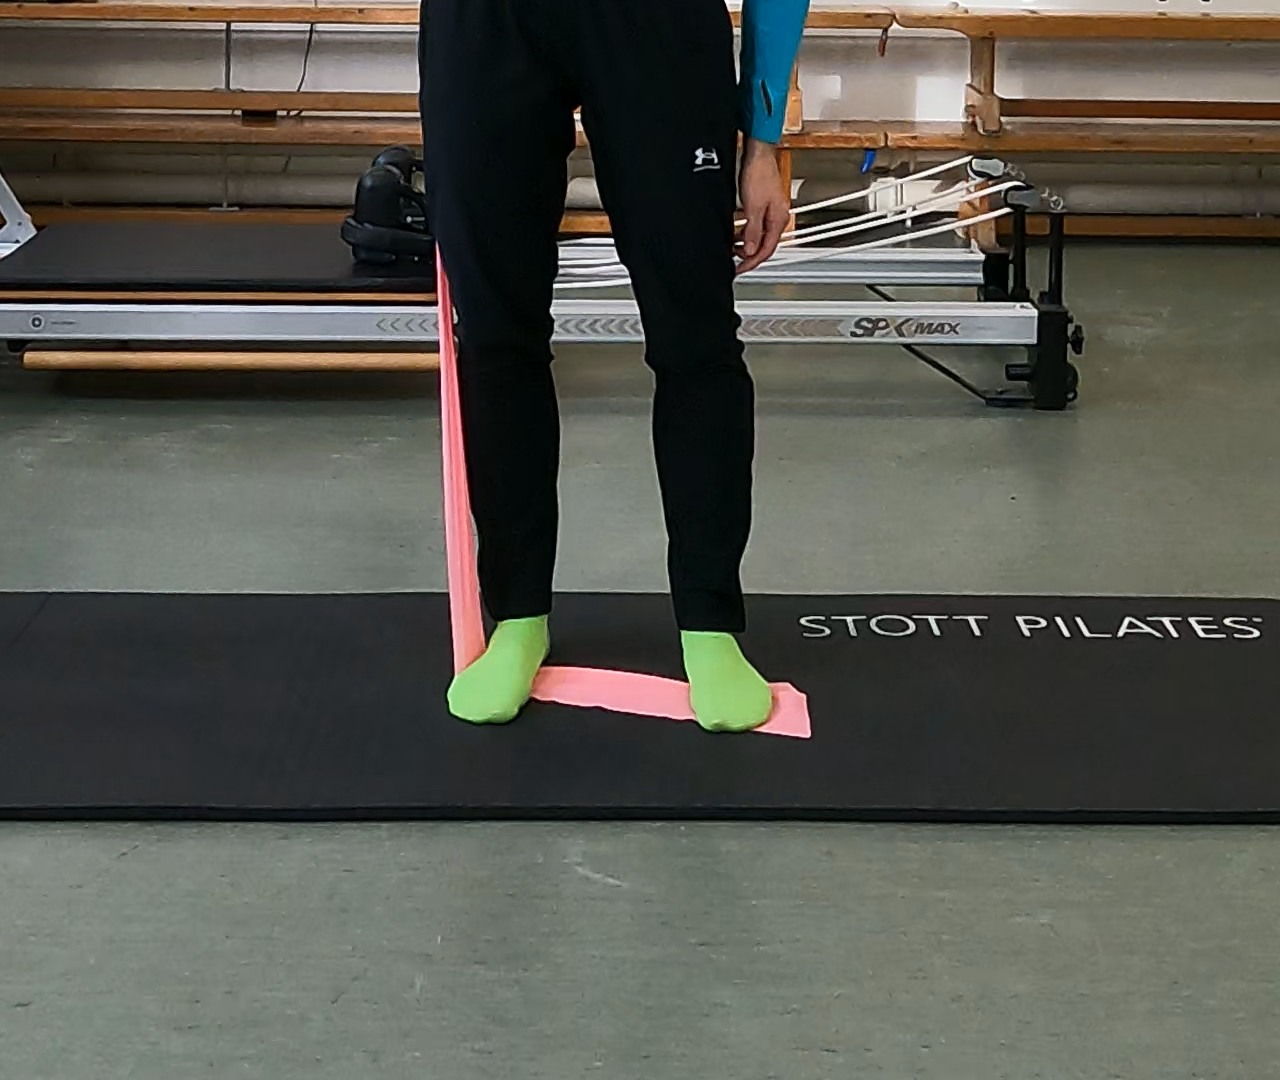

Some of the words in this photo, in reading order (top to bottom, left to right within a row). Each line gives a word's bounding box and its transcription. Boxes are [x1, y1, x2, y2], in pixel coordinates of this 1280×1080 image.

[914, 322, 961, 335] MAX
[799, 614, 989, 638] STOTT
[1015, 615, 1263, 639] PILATES
